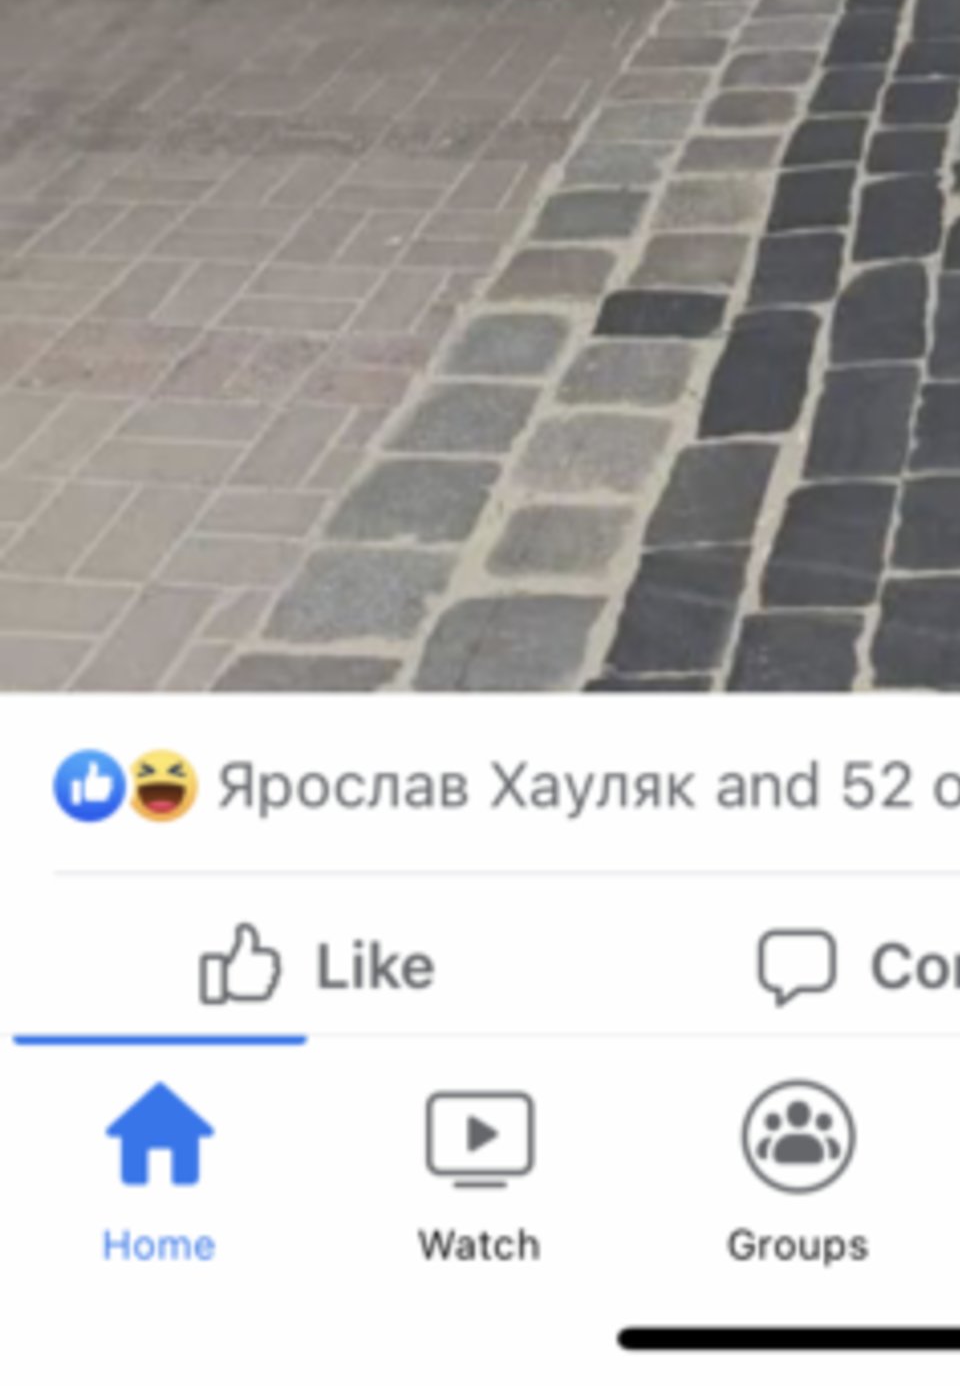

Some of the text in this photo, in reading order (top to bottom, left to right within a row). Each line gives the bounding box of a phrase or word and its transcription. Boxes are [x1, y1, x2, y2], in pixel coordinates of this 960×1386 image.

[221, 762, 467, 817] Ярослав
[492, 763, 693, 818] Хауляк
[718, 761, 817, 807] and
[844, 761, 911, 808] 52
[317, 940, 435, 989] Like
[103, 1229, 215, 1261] Home
[418, 1228, 540, 1261] Watch
[727, 1228, 868, 1270] Groups
